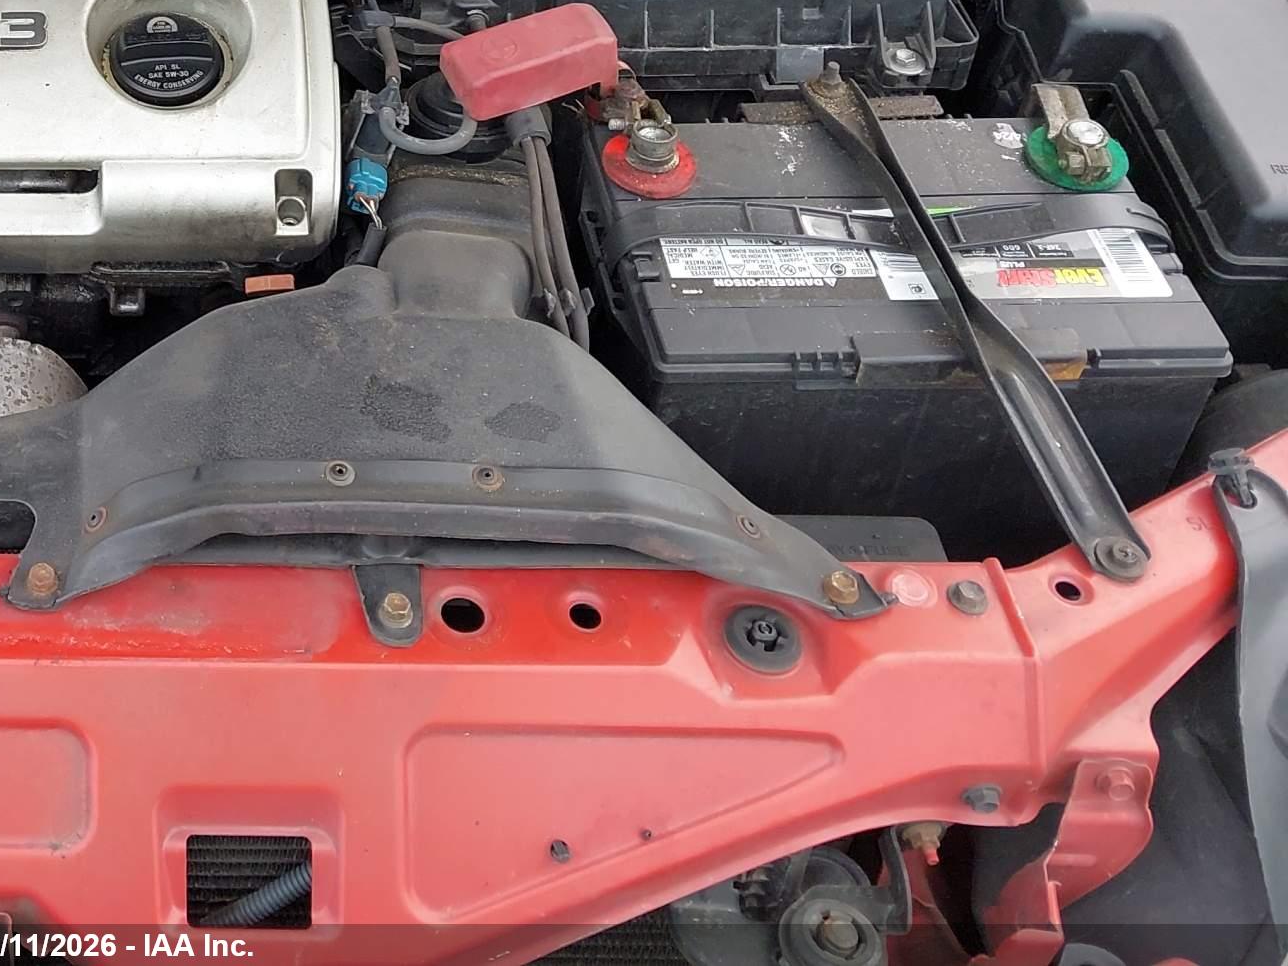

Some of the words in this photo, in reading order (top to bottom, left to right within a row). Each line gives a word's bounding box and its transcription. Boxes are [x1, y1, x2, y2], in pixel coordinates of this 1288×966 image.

[134, 74, 161, 89] ENERGY
[163, 70, 204, 89] CONSERVING
[714, 278, 825, 288] DANGER/POISON
[996, 265, 1107, 287] EverStart
